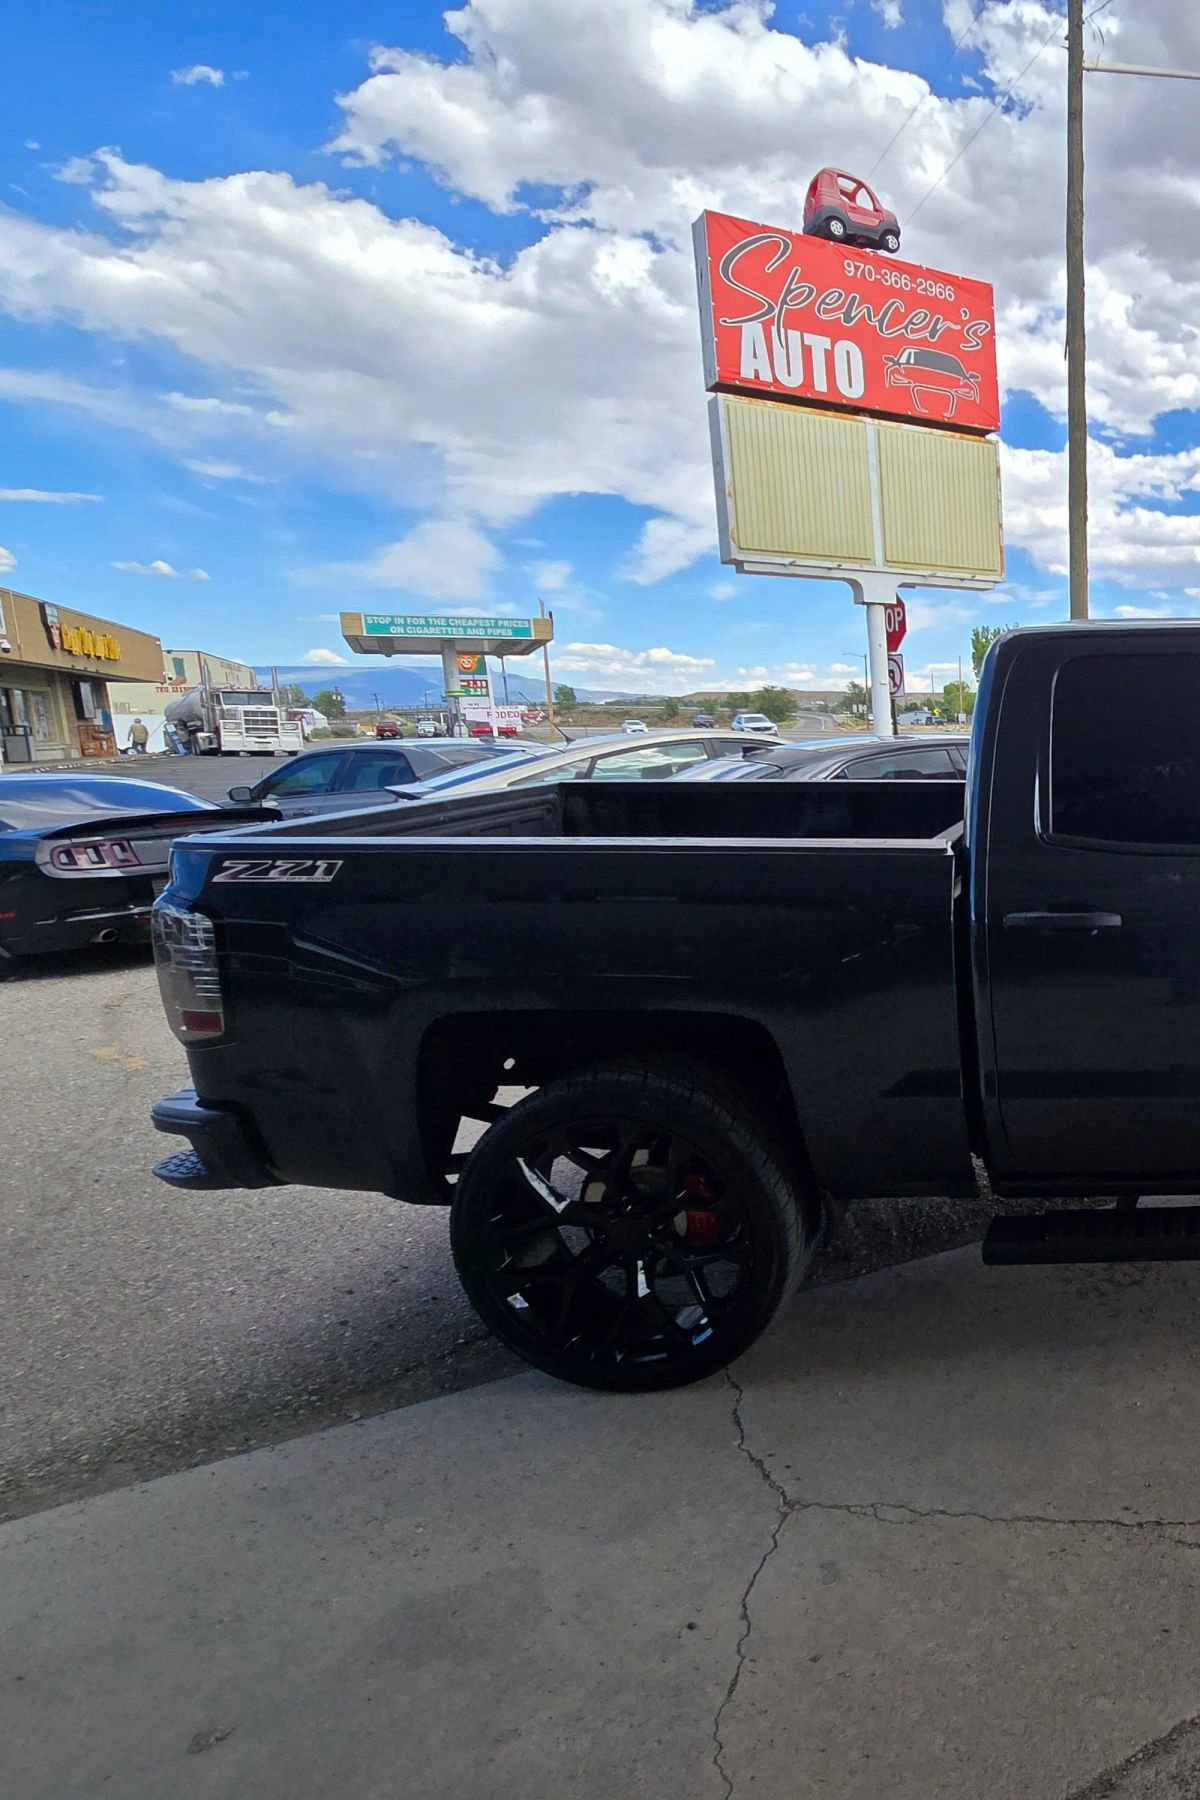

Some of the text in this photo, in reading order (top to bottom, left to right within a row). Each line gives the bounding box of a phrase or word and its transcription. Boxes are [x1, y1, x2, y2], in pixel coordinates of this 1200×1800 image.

[719, 233, 991, 351] Spencer's
[843, 259, 956, 302] 970-366-2966
[740, 322, 865, 399] AUTO
[366, 616, 529, 628] STOP IN FOR THE CHEAPEST PRICES
[390, 626, 513, 636] ON CIGARETTES AND PIPES
[885, 607, 904, 633] OP
[211, 859, 345, 883] Z71
